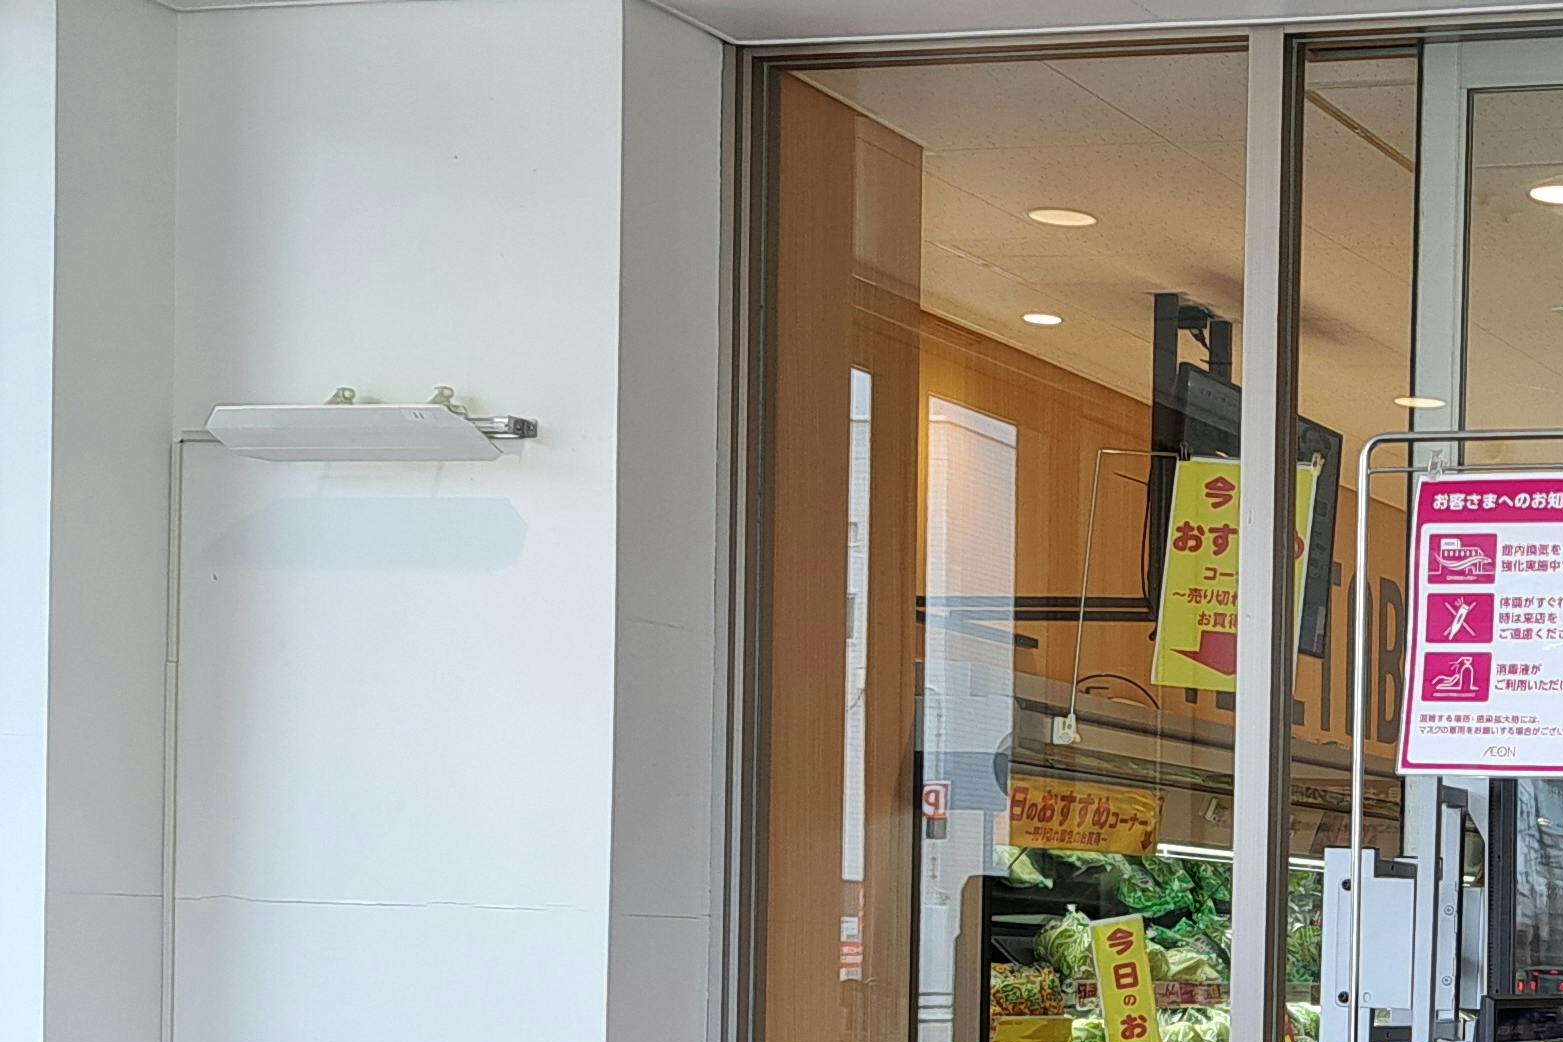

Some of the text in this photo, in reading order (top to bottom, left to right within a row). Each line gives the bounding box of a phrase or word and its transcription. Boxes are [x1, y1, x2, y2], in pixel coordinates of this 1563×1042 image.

[1499, 612, 1558, 624] 時は来店を
[1496, 663, 1542, 676] 消毒液が
